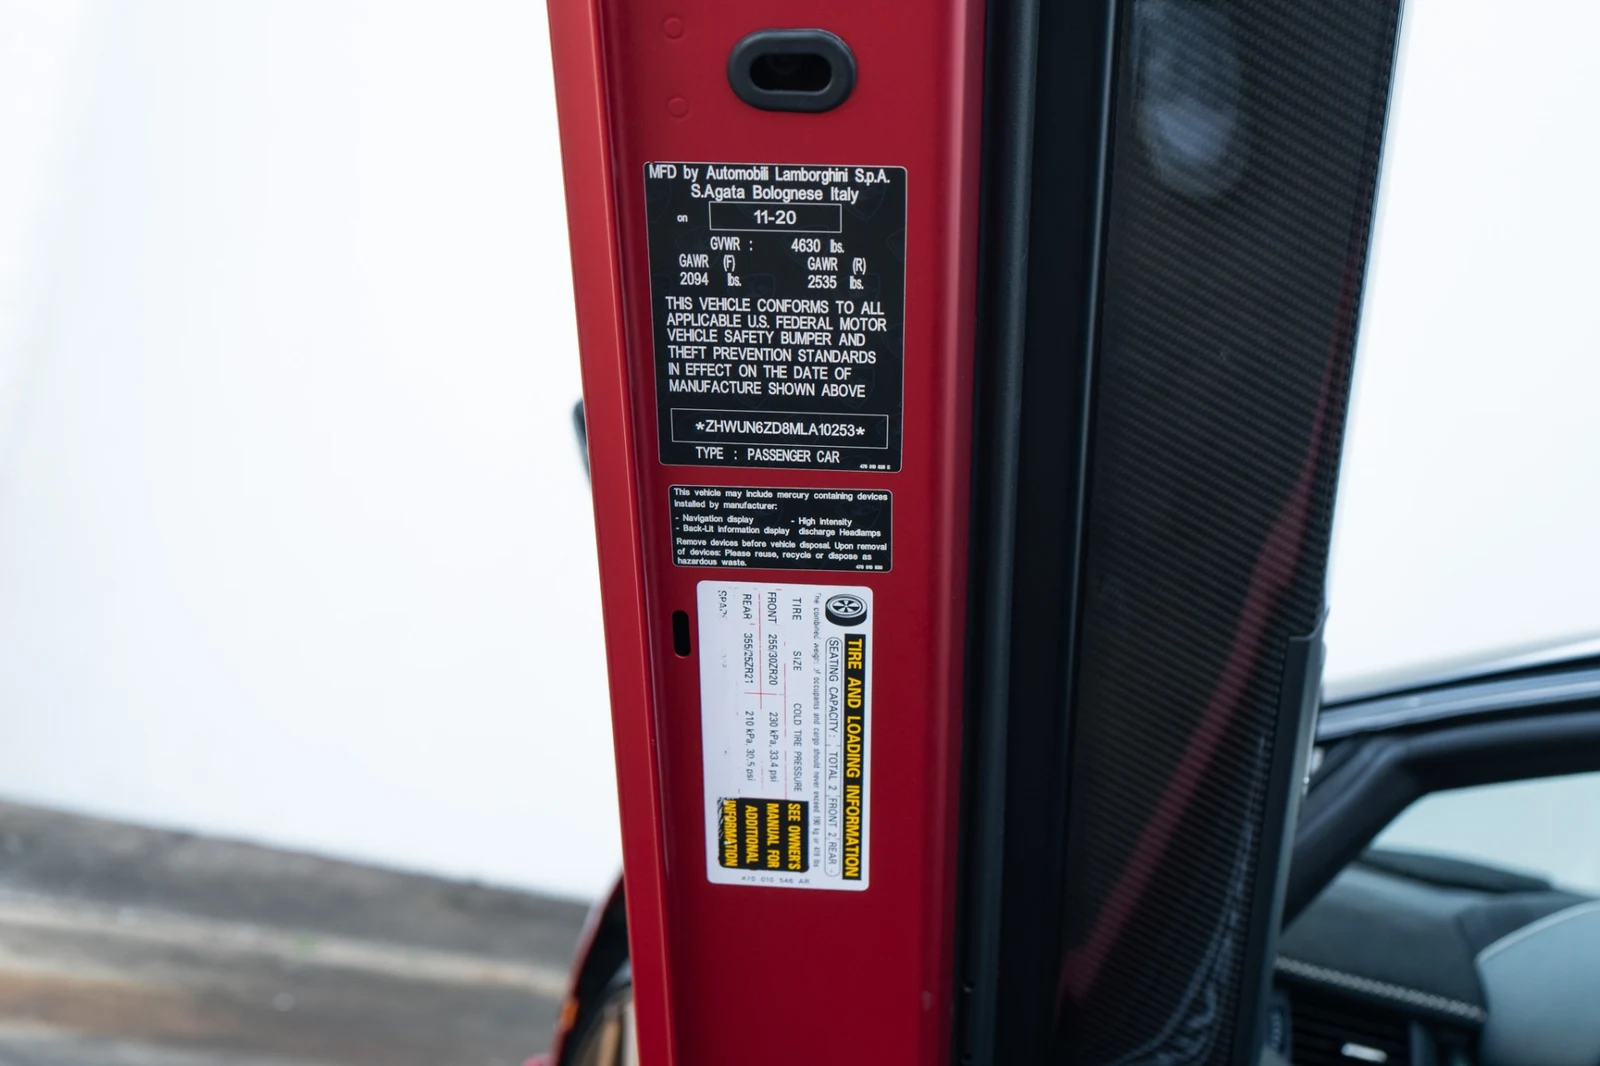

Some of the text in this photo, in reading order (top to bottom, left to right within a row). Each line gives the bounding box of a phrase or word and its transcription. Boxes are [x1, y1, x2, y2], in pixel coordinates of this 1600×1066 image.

[649, 165, 890, 186] MFD by Automobili Lamborghini S.p.A.
[691, 184, 859, 204] S.Agata Bolognese Italy
[754, 210, 796, 225] 11-20
[710, 237, 740, 250] GVWR
[791, 239, 820, 252] 4630
[830, 239, 844, 253] lbs.
[679, 254, 735, 271] GAWR (F)
[808, 257, 866, 274] GAWR (R)
[680, 272, 741, 286] 2094 lbs.
[808, 275, 864, 289] 2535 lbs.
[666, 296, 884, 314] THIS VEHICLE CONFORMS TO ALL
[667, 313, 886, 331] APPLICABLE U.S. FEDERAL MOTOR
[667, 328, 865, 346] VEHICLE SAFETY BUMPER AND
[668, 345, 876, 364] THEFT PREVENTION STANDARDS
[669, 363, 852, 380] IN EFFECT ON THE DATE OF
[669, 379, 865, 397] MANUFACTURE SHOWN ABOVE
[696, 447, 723, 459] TYPE
[748, 449, 811, 462] PASSENGER
[817, 450, 840, 463] CAR
[694, 489, 721, 497] vehicle
[726, 490, 741, 499] may
[814, 492, 853, 501] containing
[709, 501, 719, 510] by
[723, 501, 778, 510] manufacturer:
[683, 514, 723, 524] Navigation
[727, 515, 753, 525] display
[799, 518, 816, 526] High
[764, 526, 790, 536] display
[799, 528, 881, 538] discharge Headlamps
[710, 538, 738, 547] devices
[742, 539, 766, 548] before
[771, 540, 795, 548] vehicle
[835, 542, 853, 551] Upon
[725, 549, 751, 557] Please
[755, 550, 779, 559] reuse,
[782, 551, 811, 560] recycle
[828, 552, 858, 561] dispose
[743, 593, 752, 619] REAR
[744, 633, 753, 683] 355/25ZR21
[829, 640, 839, 682] SEATING
[768, 592, 779, 782] FRONT 255/30ZR20 230 kPa, 33.4 psi
[792, 598, 802, 792] TIRE SIZE COLD TIRE PRESSURE
[745, 711, 754, 726] 210
[828, 752, 838, 780] TOTAL
[845, 639, 862, 877] TIRE AND LOADING INFORMATION
[746, 769, 755, 780] psi
[828, 799, 838, 828] FRONT
[724, 800, 738, 867] INFORMATION
[746, 805, 759, 863] ADDITIONAL
[767, 803, 780, 869] MANUAL FOR
[788, 803, 801, 870] SEE OWNER'S
[827, 843, 837, 864] REAR
